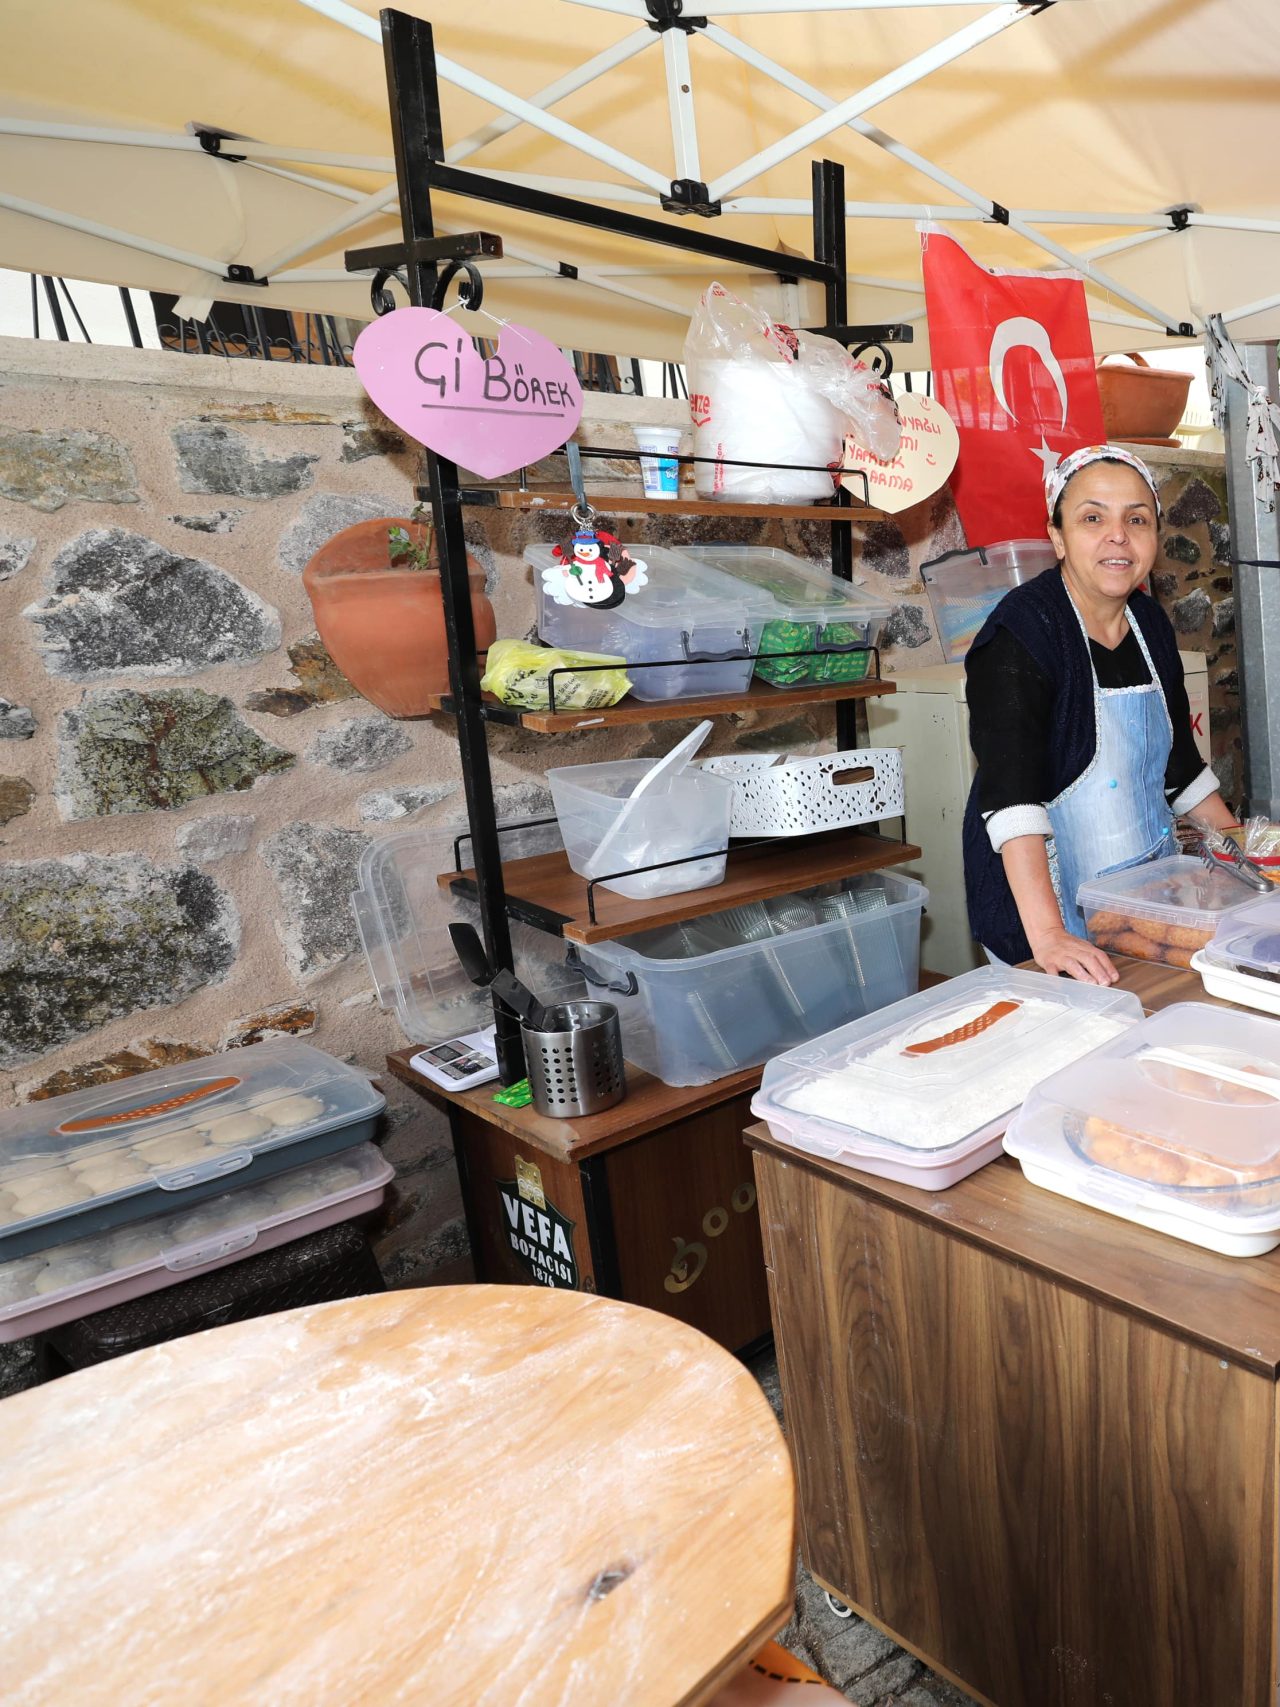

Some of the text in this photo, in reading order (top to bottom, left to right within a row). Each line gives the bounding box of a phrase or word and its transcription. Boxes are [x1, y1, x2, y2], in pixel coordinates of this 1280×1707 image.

[482, 354, 576, 408] BÖREK
[501, 1191, 573, 1263] VEFA
[510, 1232, 573, 1284] BOZACISI
[532, 1264, 555, 1288] 1876
